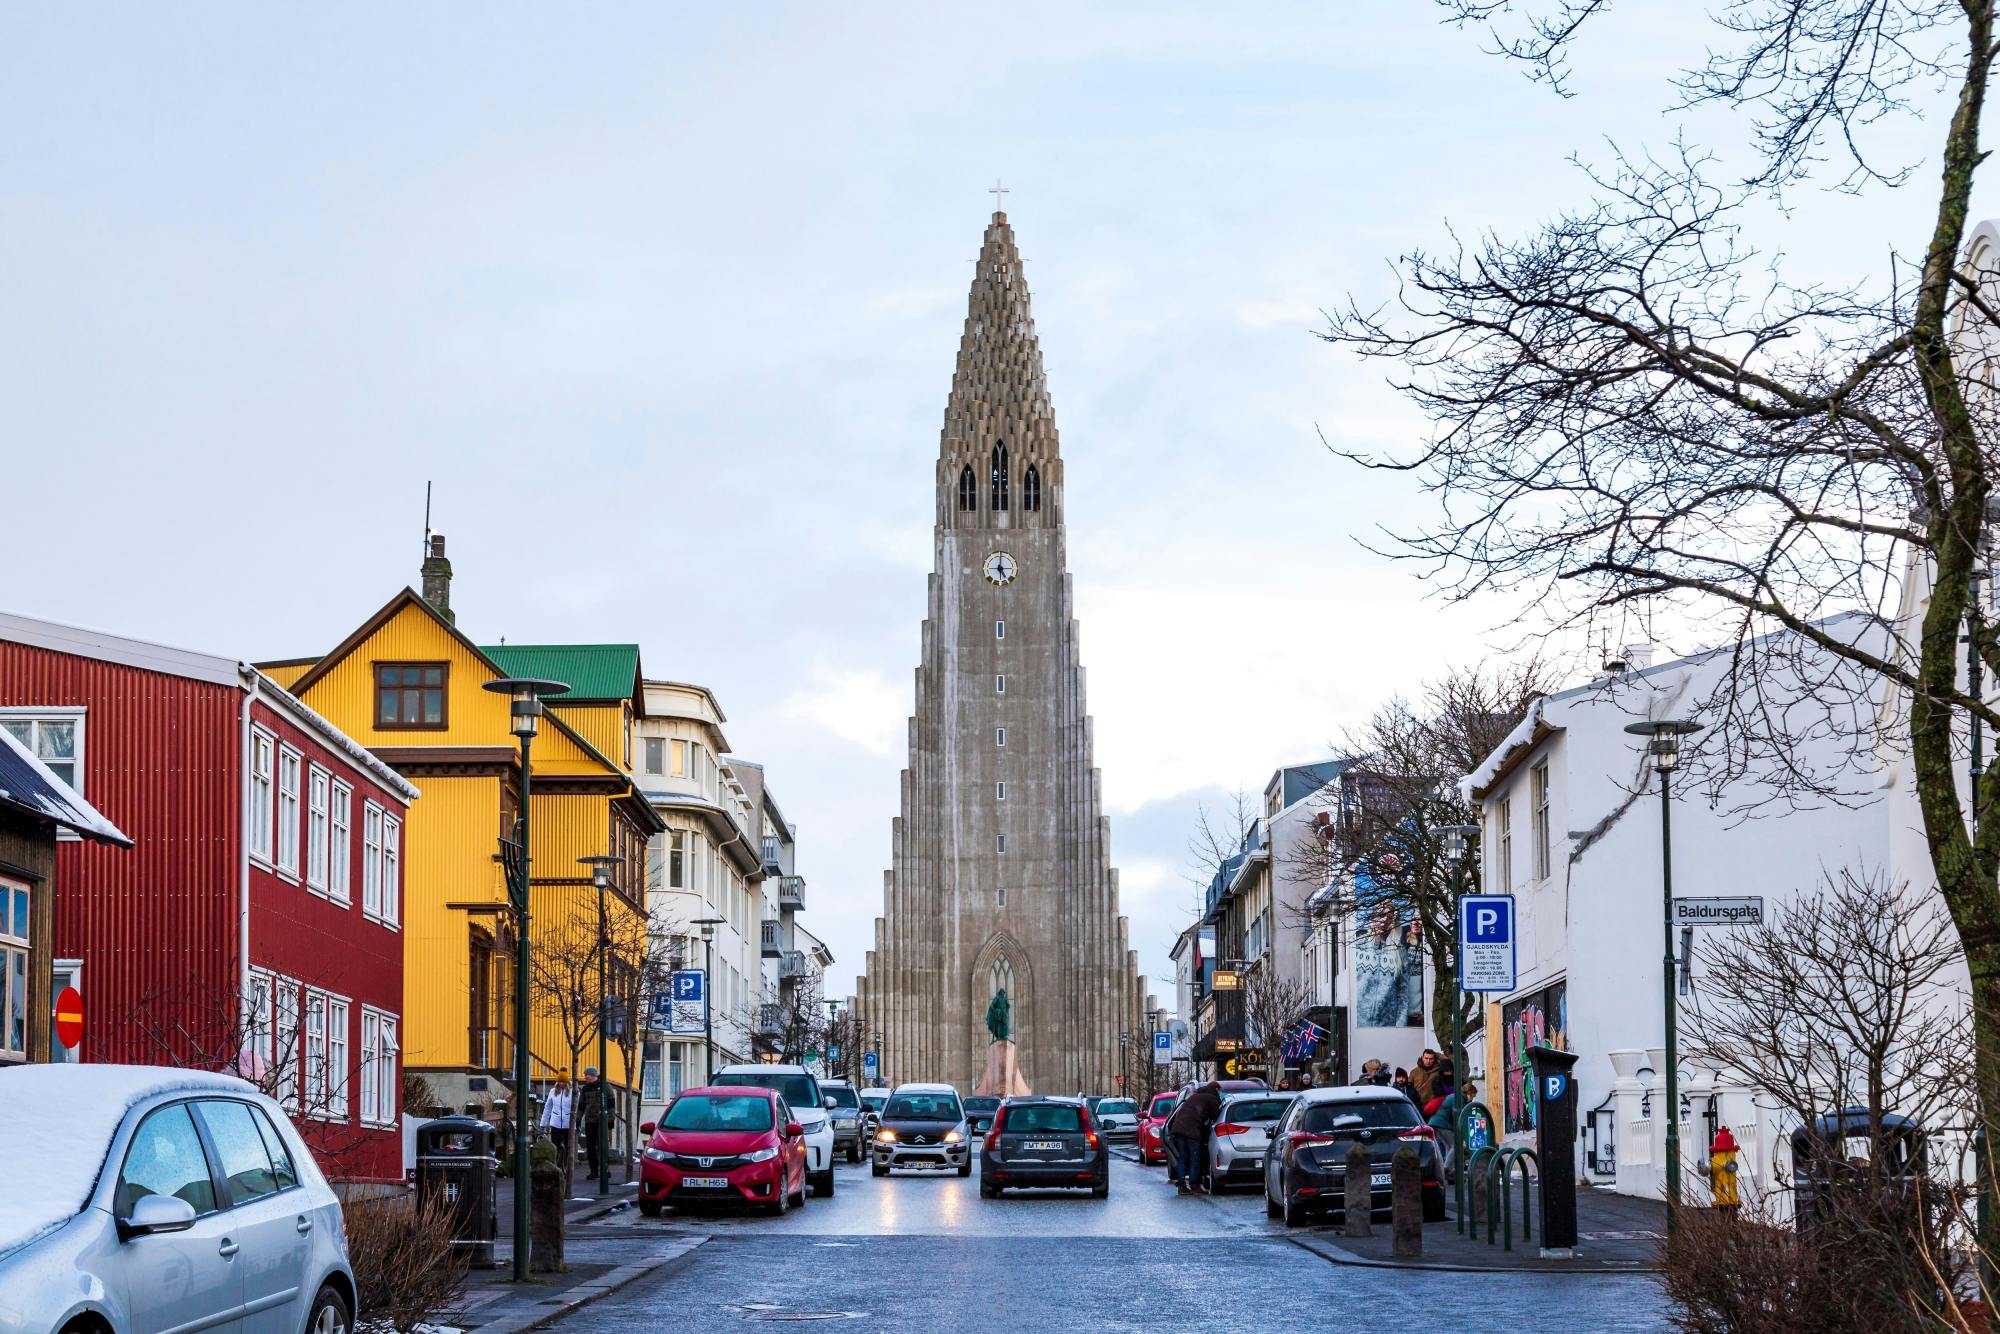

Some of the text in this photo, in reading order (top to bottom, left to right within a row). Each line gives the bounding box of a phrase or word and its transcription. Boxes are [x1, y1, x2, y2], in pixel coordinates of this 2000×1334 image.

[1678, 905, 1759, 920] Baldursgata
[681, 979, 695, 996] P
[1159, 1036, 1167, 1047] P
